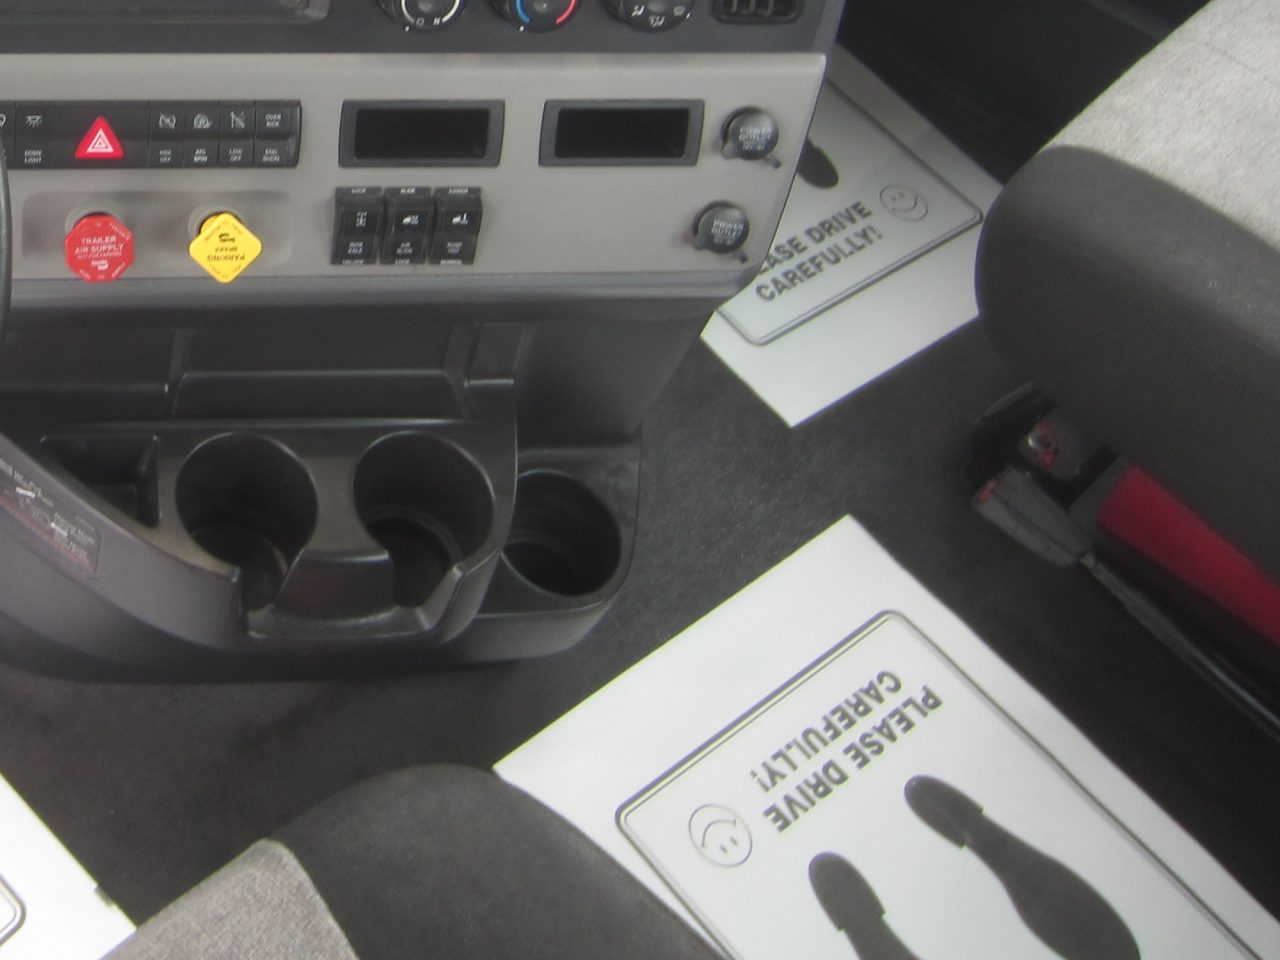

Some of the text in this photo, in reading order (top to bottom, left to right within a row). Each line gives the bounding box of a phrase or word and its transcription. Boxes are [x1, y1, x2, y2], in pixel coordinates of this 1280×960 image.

[74, 243, 124, 256] AIR SUPPLY
[82, 235, 117, 246] TRAILER
[207, 253, 245, 262] PARKING
[756, 225, 883, 301] CAREFULLY!
[759, 201, 873, 275] ASE DRIVE
[750, 671, 902, 792] CAREFULLY!
[763, 686, 943, 832] PLEASE DRIVE
